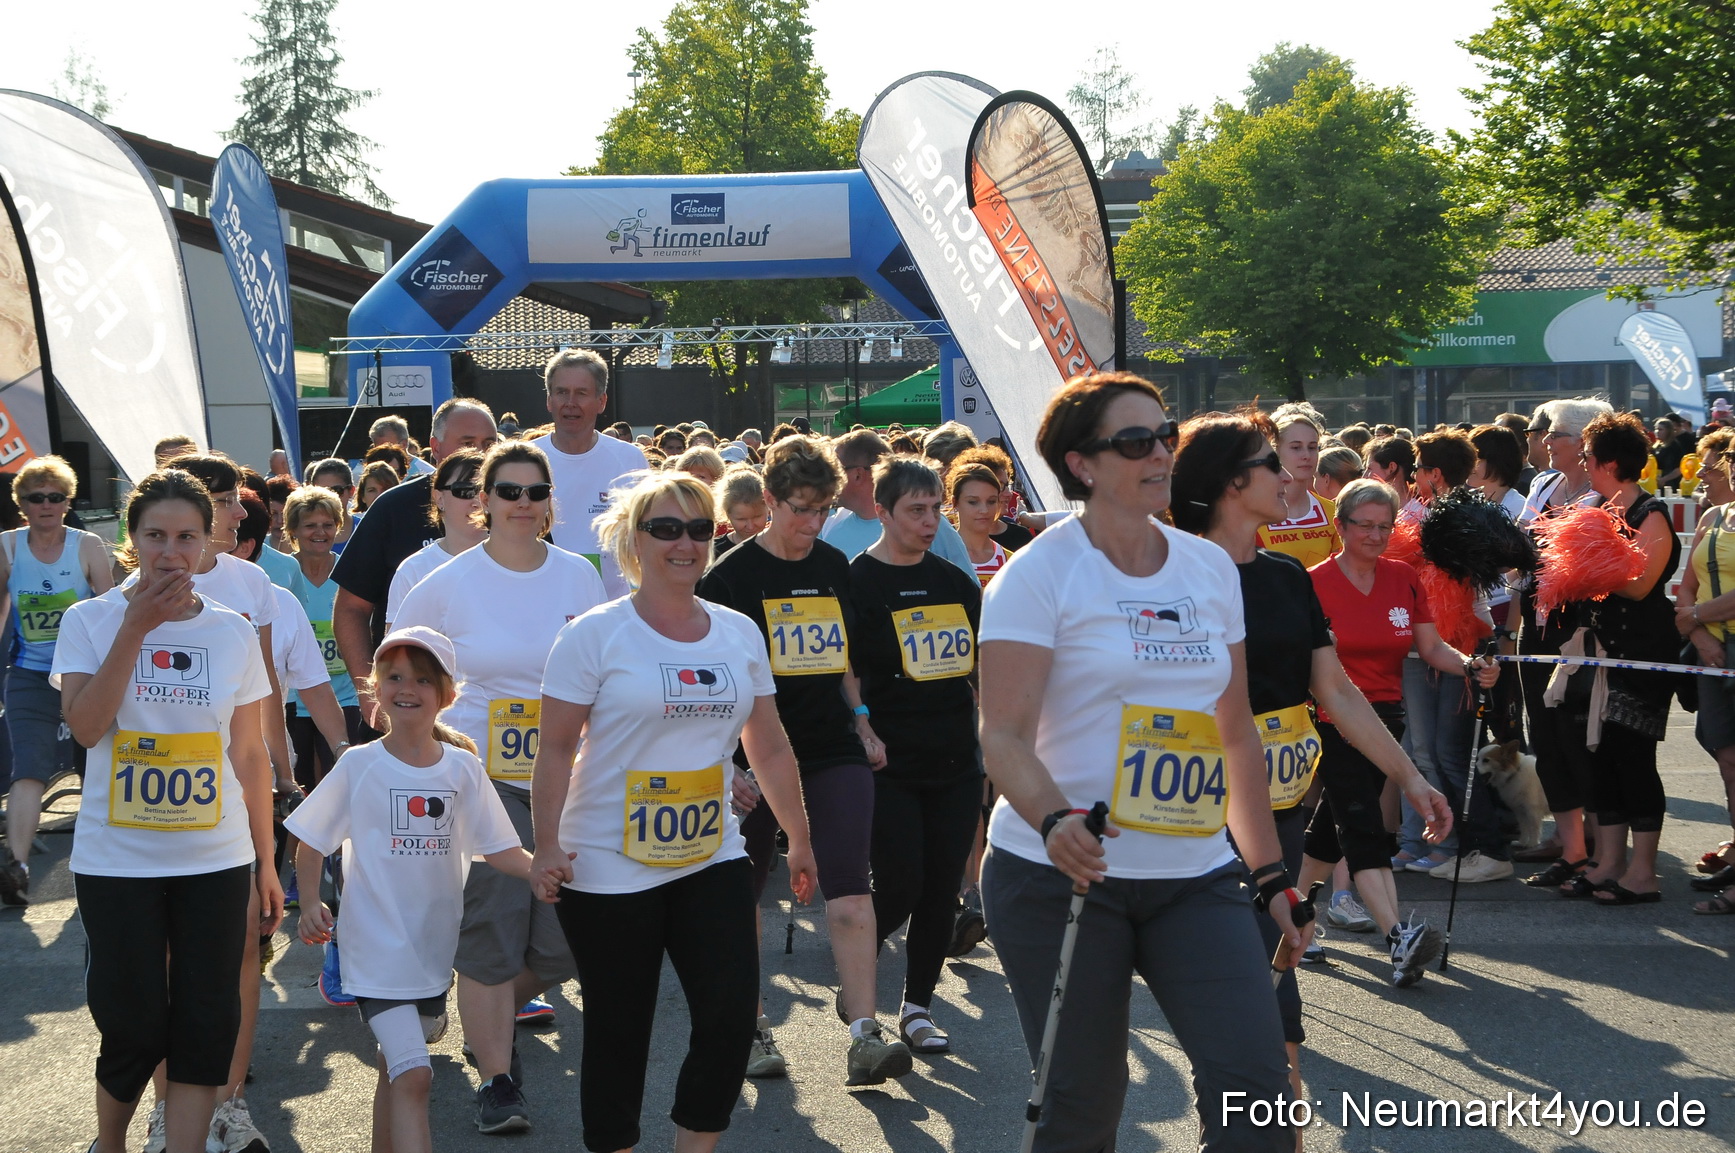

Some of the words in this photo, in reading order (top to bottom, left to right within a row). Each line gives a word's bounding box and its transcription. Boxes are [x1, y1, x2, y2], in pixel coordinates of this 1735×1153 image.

[683, 204, 722, 214] Fischer
[653, 224, 772, 248] firmenlauf
[653, 248, 702, 257] neumarkt
[424, 271, 489, 284] Fischer
[1269, 533, 1300, 545] MAX
[773, 623, 845, 656] 1134
[903, 629, 971, 662] 1126
[1133, 641, 1213, 656] POLGER
[1134, 654, 1216, 663] TRANSPORT
[136, 685, 210, 700] POLGER
[135, 697, 211, 707] TRANSPORT
[664, 704, 735, 714] POLGER
[1142, 726, 1189, 740] firmenlauf
[501, 728, 539, 760] 90
[1128, 739, 1165, 751] walken
[130, 747, 170, 757] firmenlauf
[119, 757, 150, 767] walken
[1123, 749, 1226, 805] 1004
[116, 765, 217, 806] 1003
[642, 787, 681, 795] firmenlauf
[144, 807, 166, 815] Bettina
[1153, 804, 1180, 813] Kirsten
[133, 814, 152, 822] Polger
[630, 799, 720, 843] 1002
[1140, 813, 1160, 822] Polger
[1163, 815, 1190, 825] Transport
[391, 838, 451, 849] POLGER
[652, 844, 680, 852] Sieglinde
[667, 851, 691, 859] Transport
